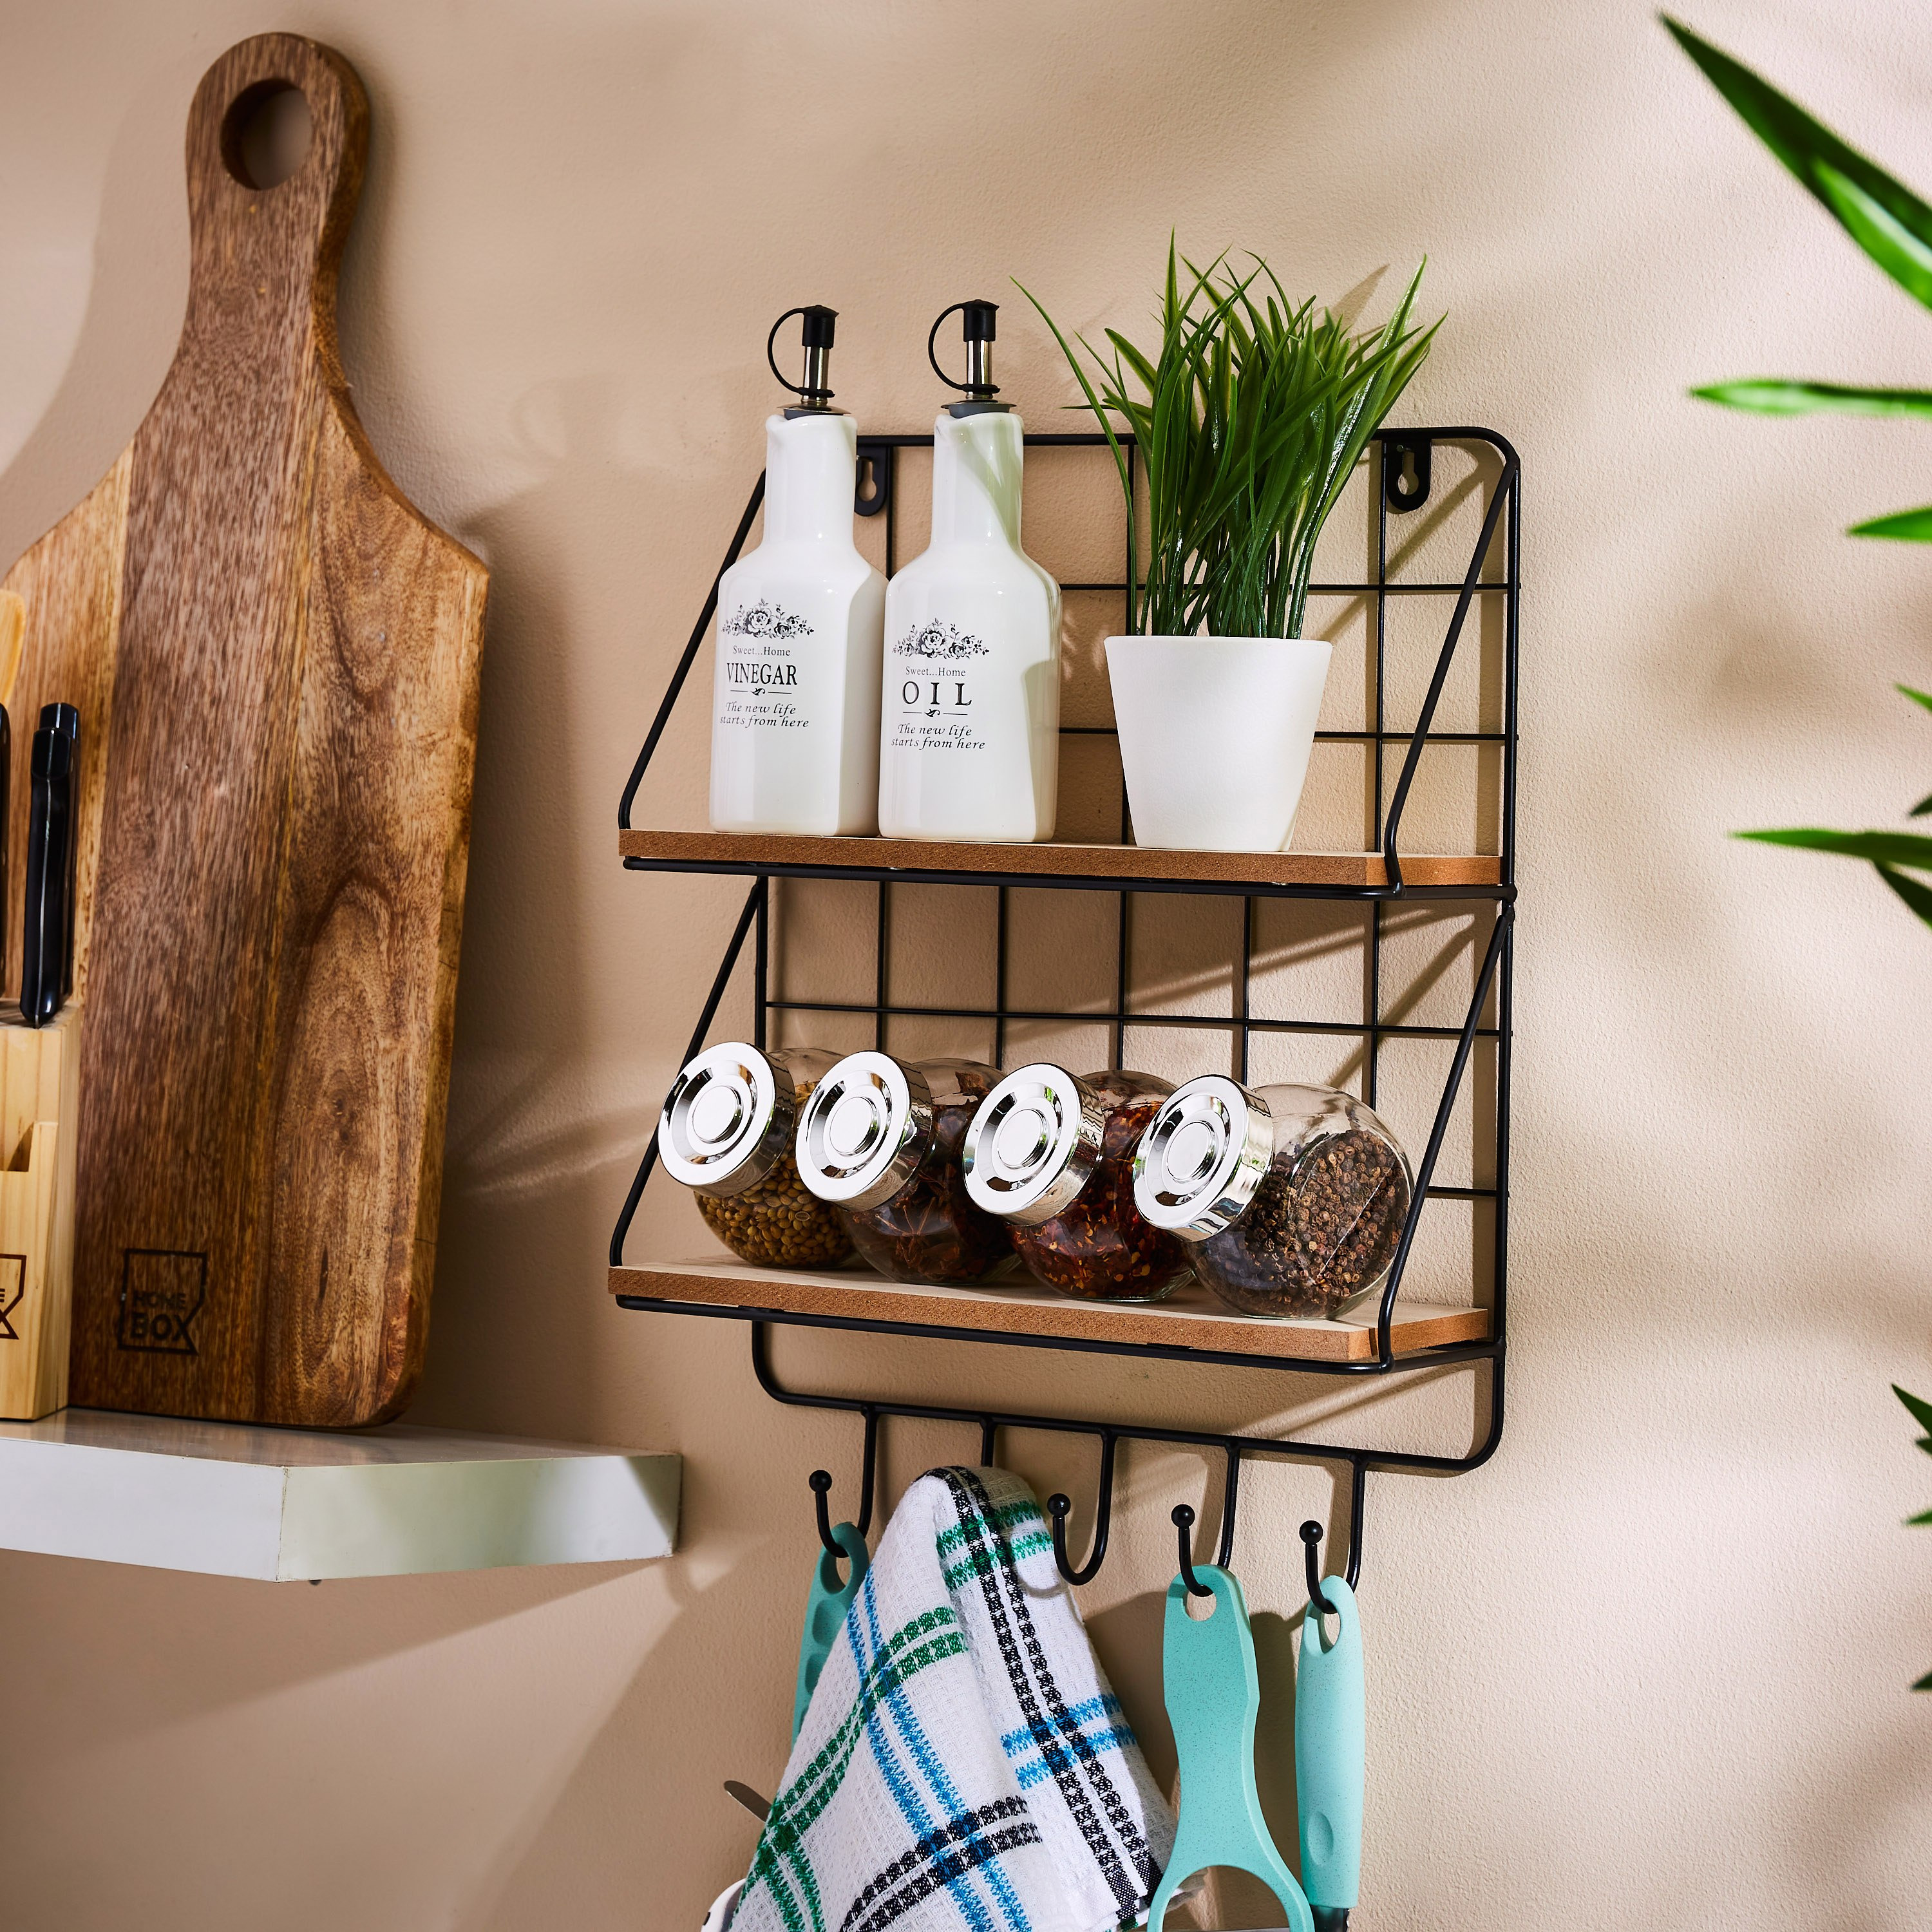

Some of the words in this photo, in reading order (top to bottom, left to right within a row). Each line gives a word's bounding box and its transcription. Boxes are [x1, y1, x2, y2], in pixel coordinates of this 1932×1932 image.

[726, 663, 798, 685] VINEGAR
[902, 681, 972, 706] OIL
[725, 701, 742, 712] The
[773, 703, 796, 717] life
[720, 715, 746, 724] starts
[745, 714, 777, 728] from
[781, 716, 809, 727] here
[898, 723, 916, 734] The
[949, 724, 972, 739] life
[891, 737, 920, 746] starts
[918, 736, 952, 750] from
[956, 737, 985, 749] here
[132, 1290, 187, 1310] HOME
[130, 1311, 193, 1343] BOX
